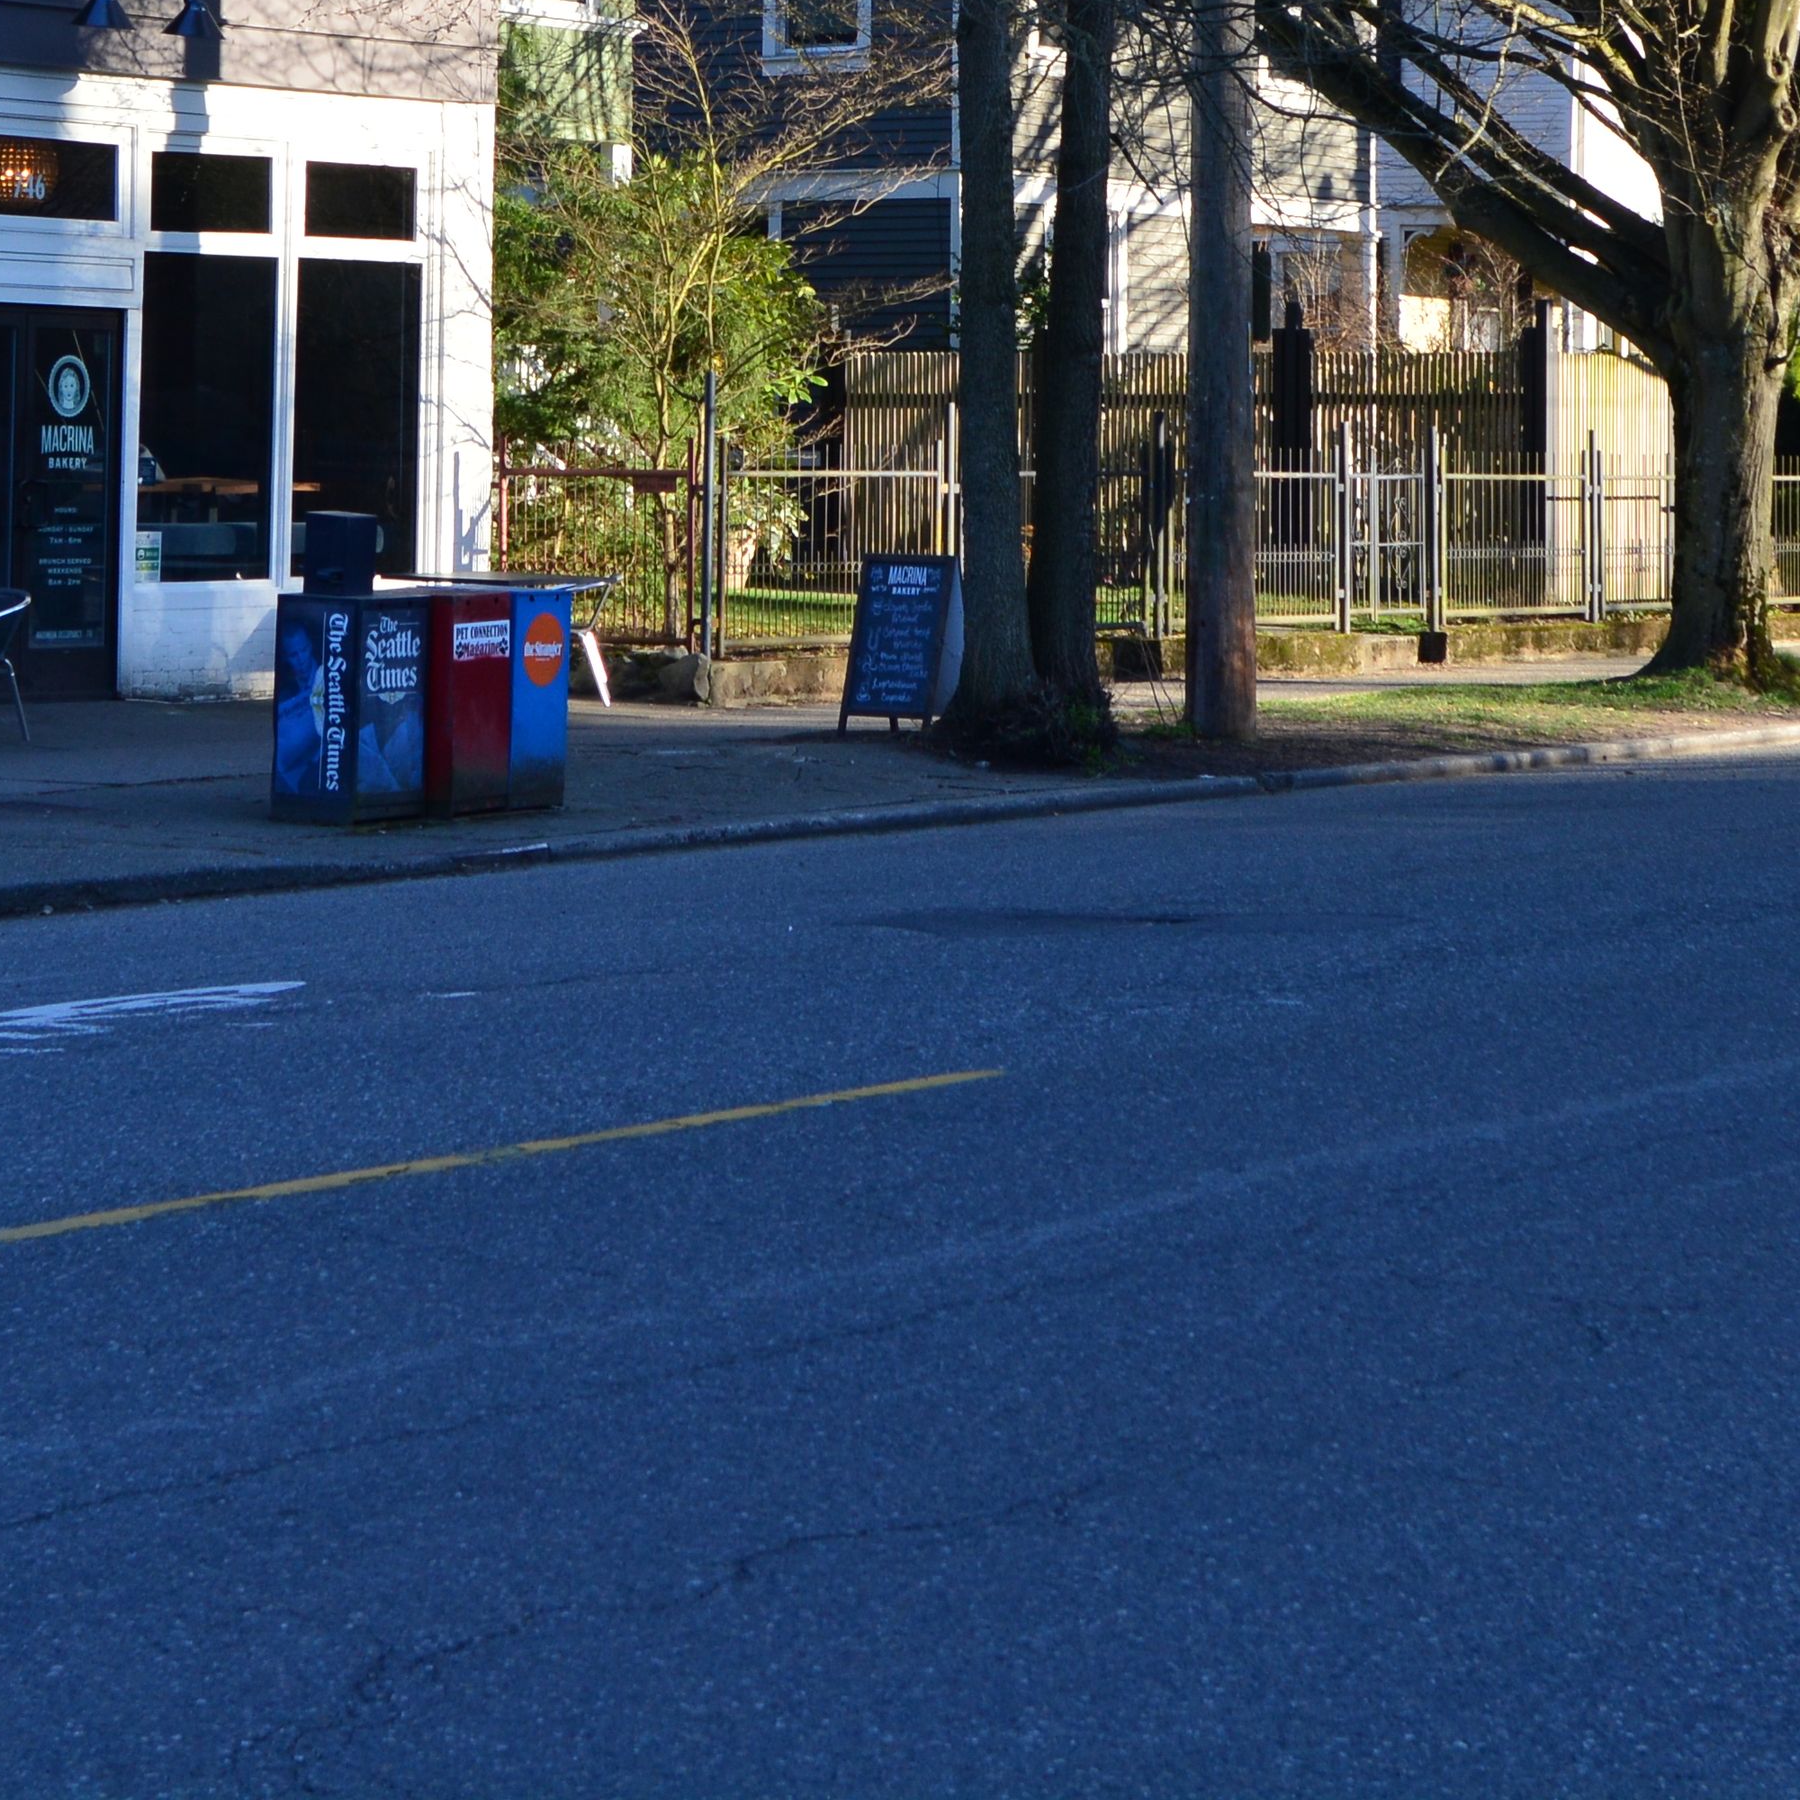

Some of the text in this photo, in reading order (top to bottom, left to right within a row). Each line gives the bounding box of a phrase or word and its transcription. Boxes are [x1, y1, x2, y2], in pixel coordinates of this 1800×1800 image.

[14, 173, 46, 201] 746
[41, 425, 94, 455] MACRINA
[49, 457, 87, 469] BAKERY
[888, 565, 927, 587] MACRINA
[892, 587, 921, 596] BAKERY
[380, 616, 399, 634] The
[456, 624, 508, 640] PET CONNECTION
[365, 629, 421, 660] Seattle
[463, 641, 500, 658] Magazine
[366, 661, 417, 691] Times
[326, 613, 349, 792] The Seattle Times
